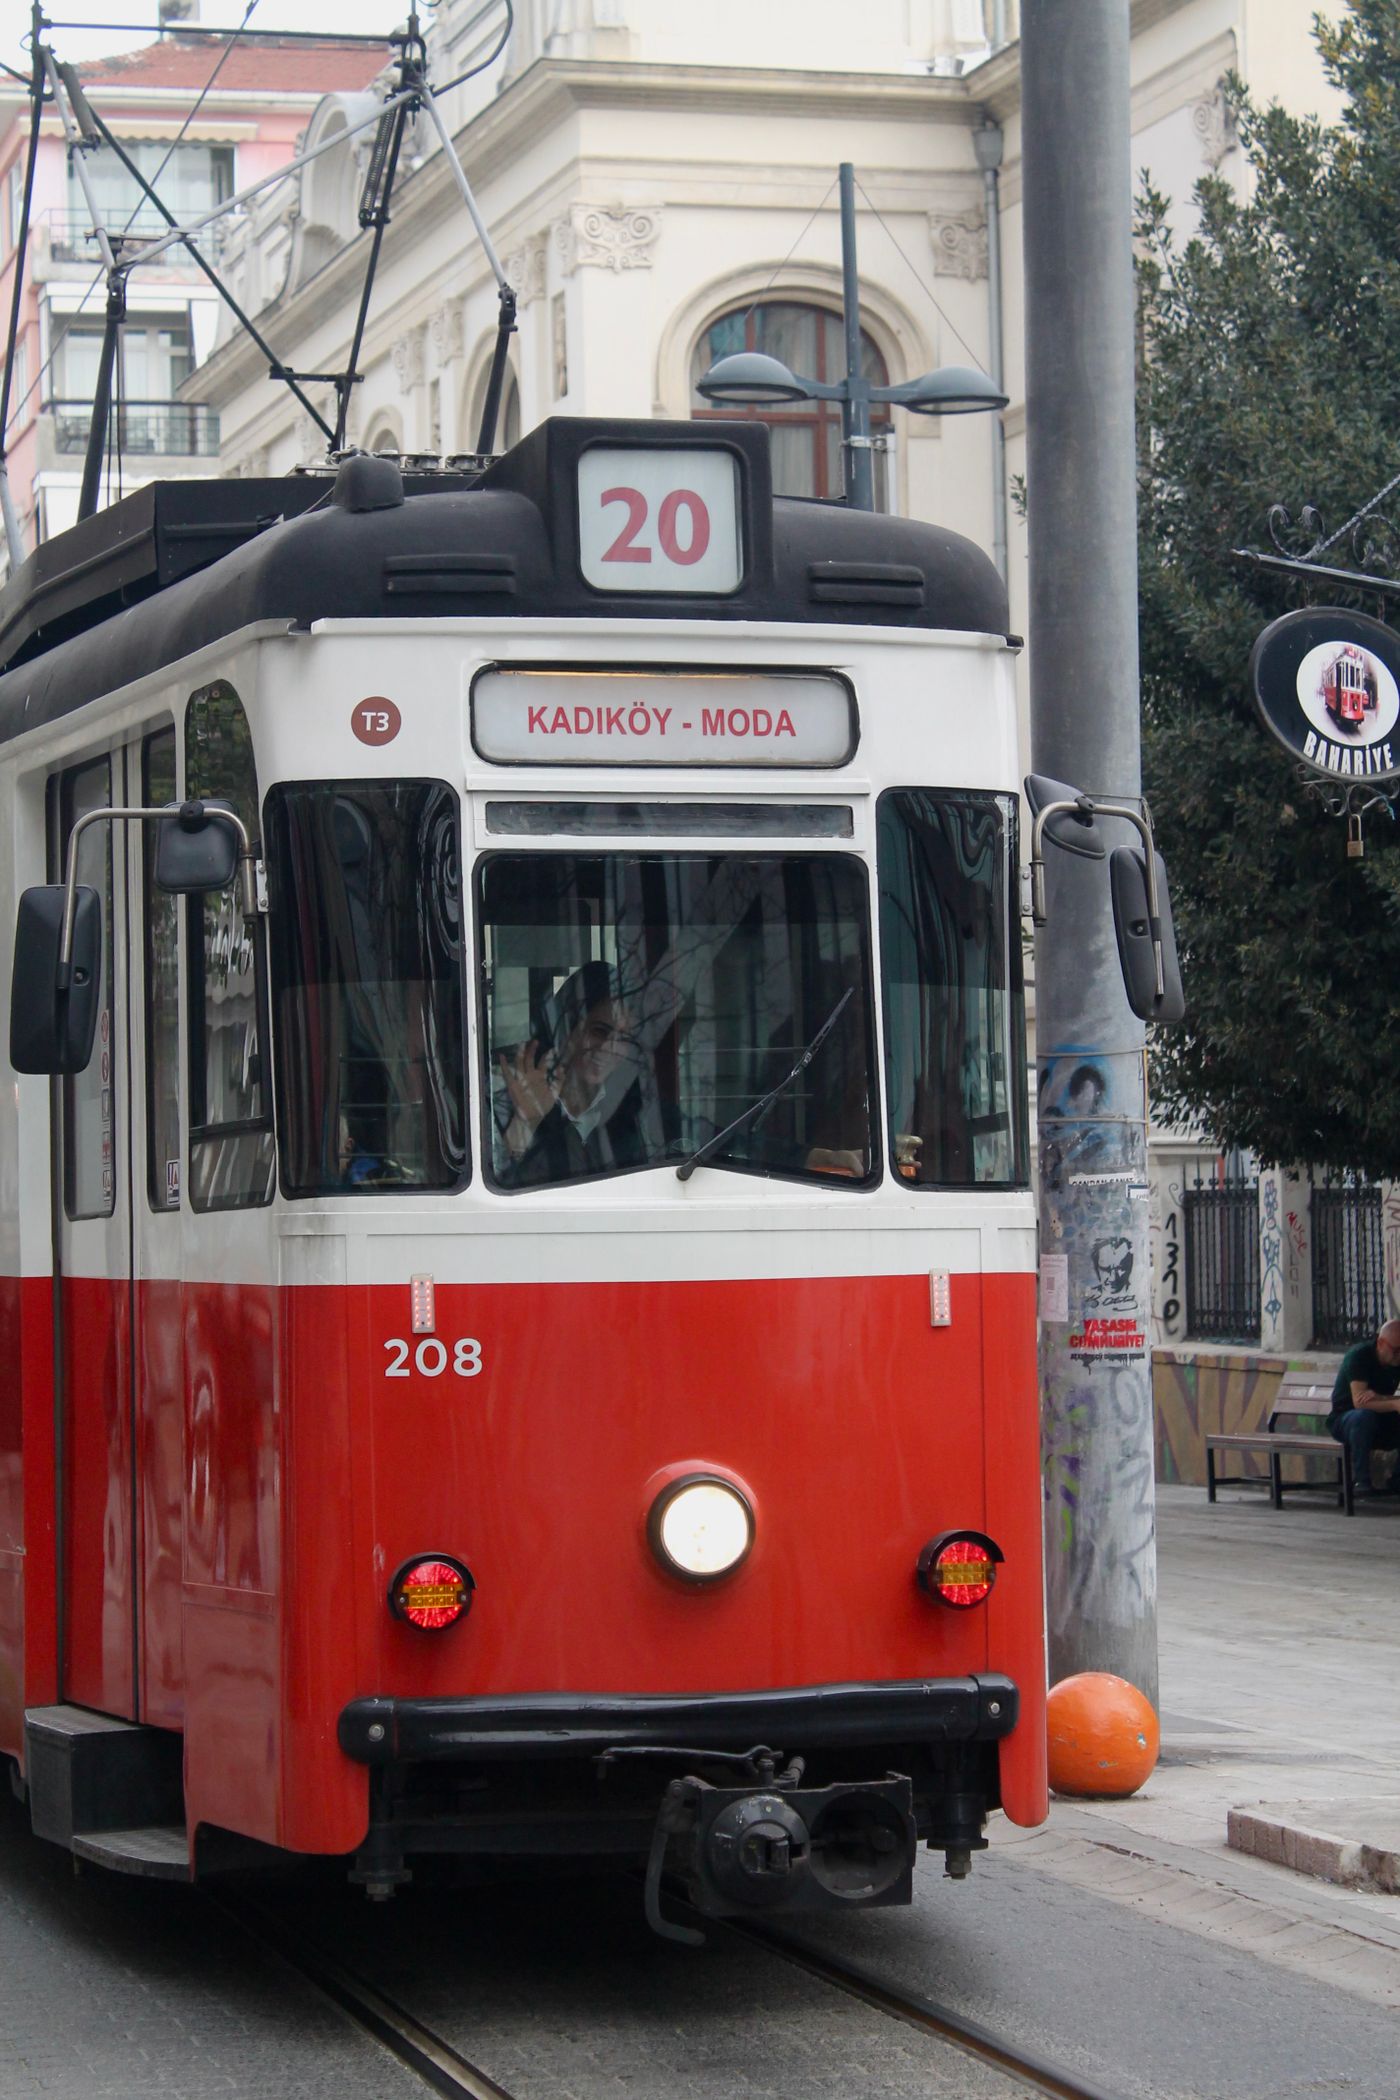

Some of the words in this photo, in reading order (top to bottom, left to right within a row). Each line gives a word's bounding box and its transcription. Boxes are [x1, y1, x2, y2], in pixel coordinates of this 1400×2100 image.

[600, 487, 710, 566] 20
[361, 711, 390, 732] T3
[527, 701, 673, 736] KADIKÖY
[701, 708, 797, 738] MODA
[1303, 730, 1394, 776] BAHARİYE
[383, 1338, 483, 1377] 208
